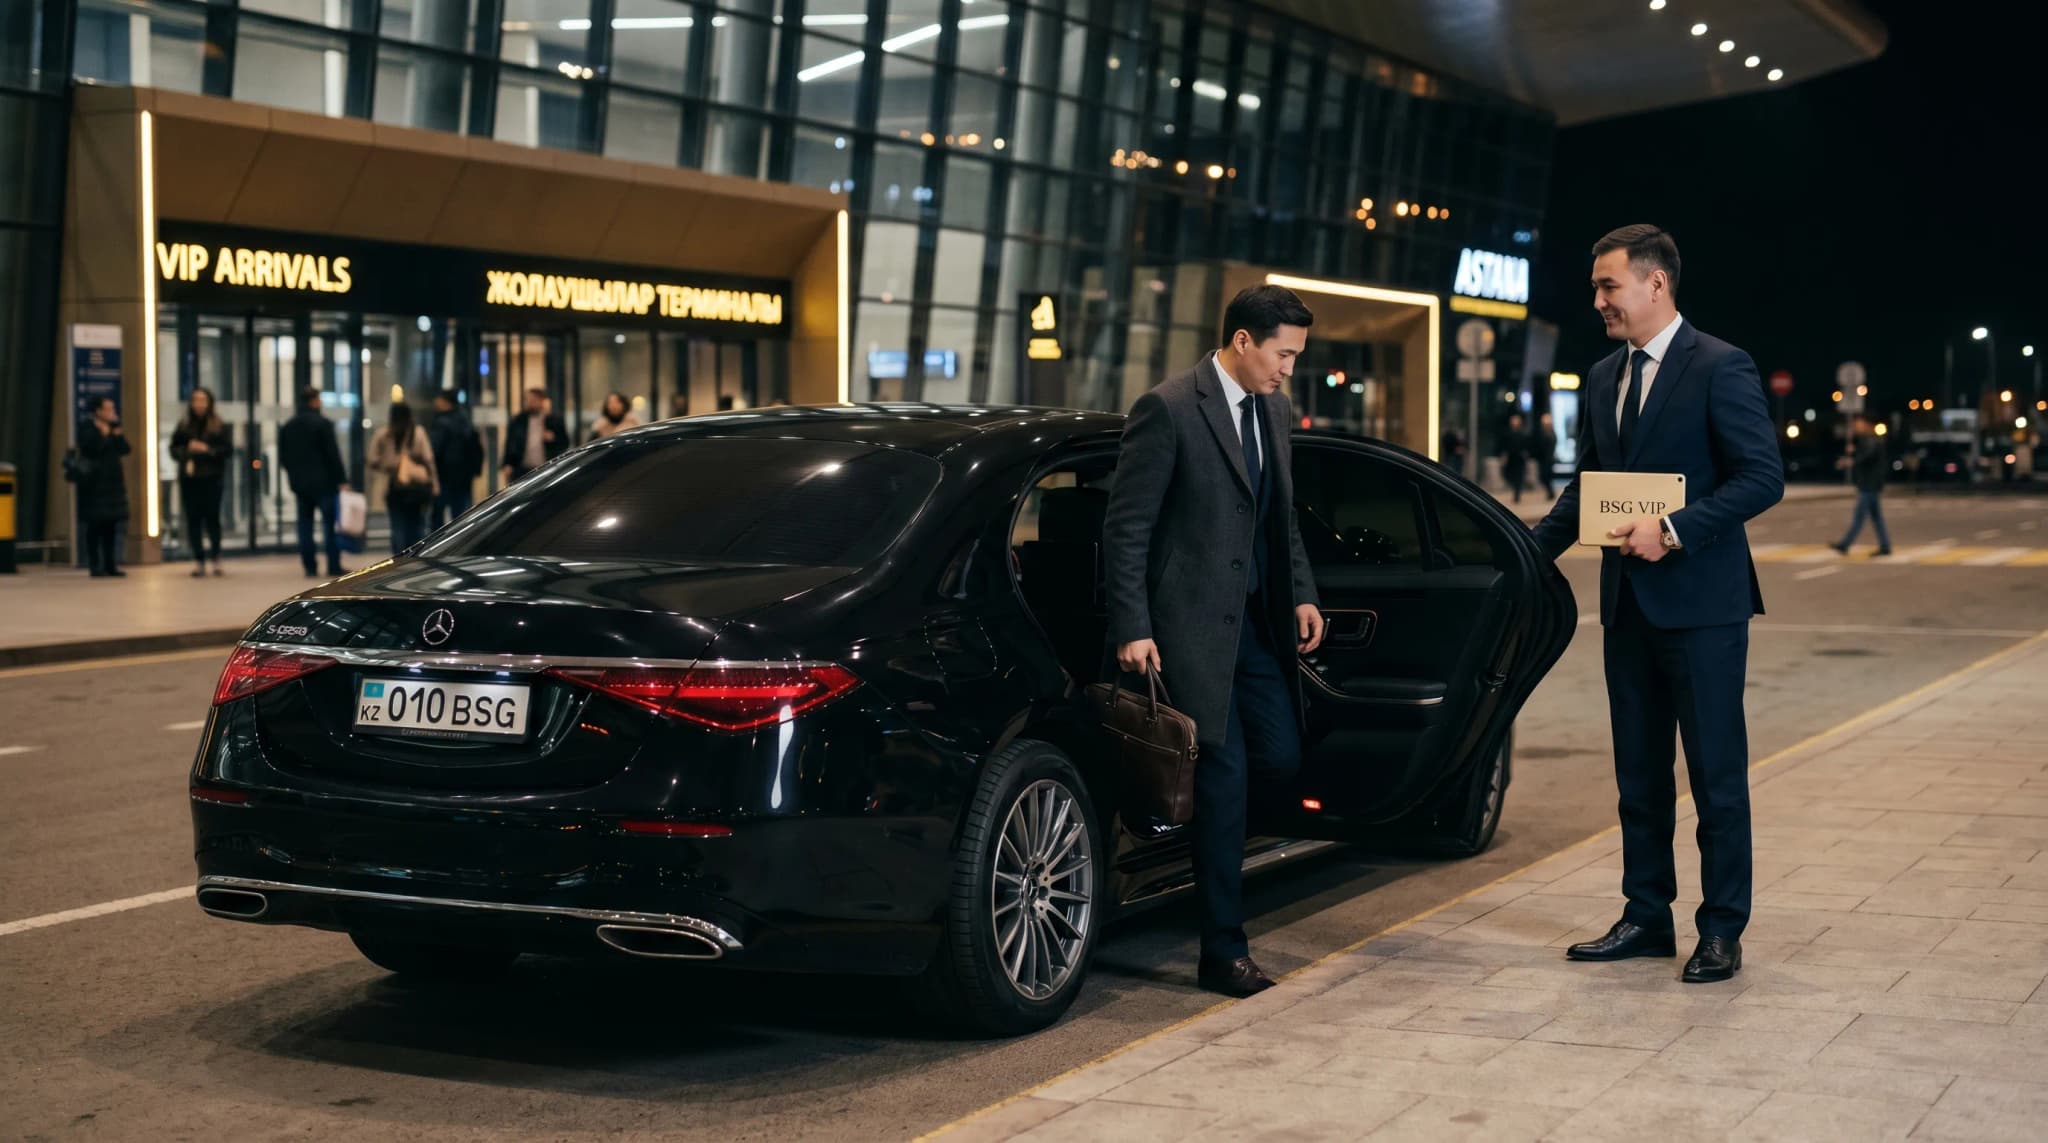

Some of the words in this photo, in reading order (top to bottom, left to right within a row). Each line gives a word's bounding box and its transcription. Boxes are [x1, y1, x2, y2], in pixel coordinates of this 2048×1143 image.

[156, 242, 209, 281] VIP
[214, 247, 351, 293] ARRIVALS
[486, 270, 655, 314] ЖОЛАУШЫЛАР
[656, 284, 782, 324] ТЕРМИНАЛЫ
[1600, 500, 1633, 514] BSG
[1638, 501, 1666, 515] VIP
[360, 705, 381, 721] KZ
[388, 686, 445, 724] 010
[451, 694, 516, 729] BSG
